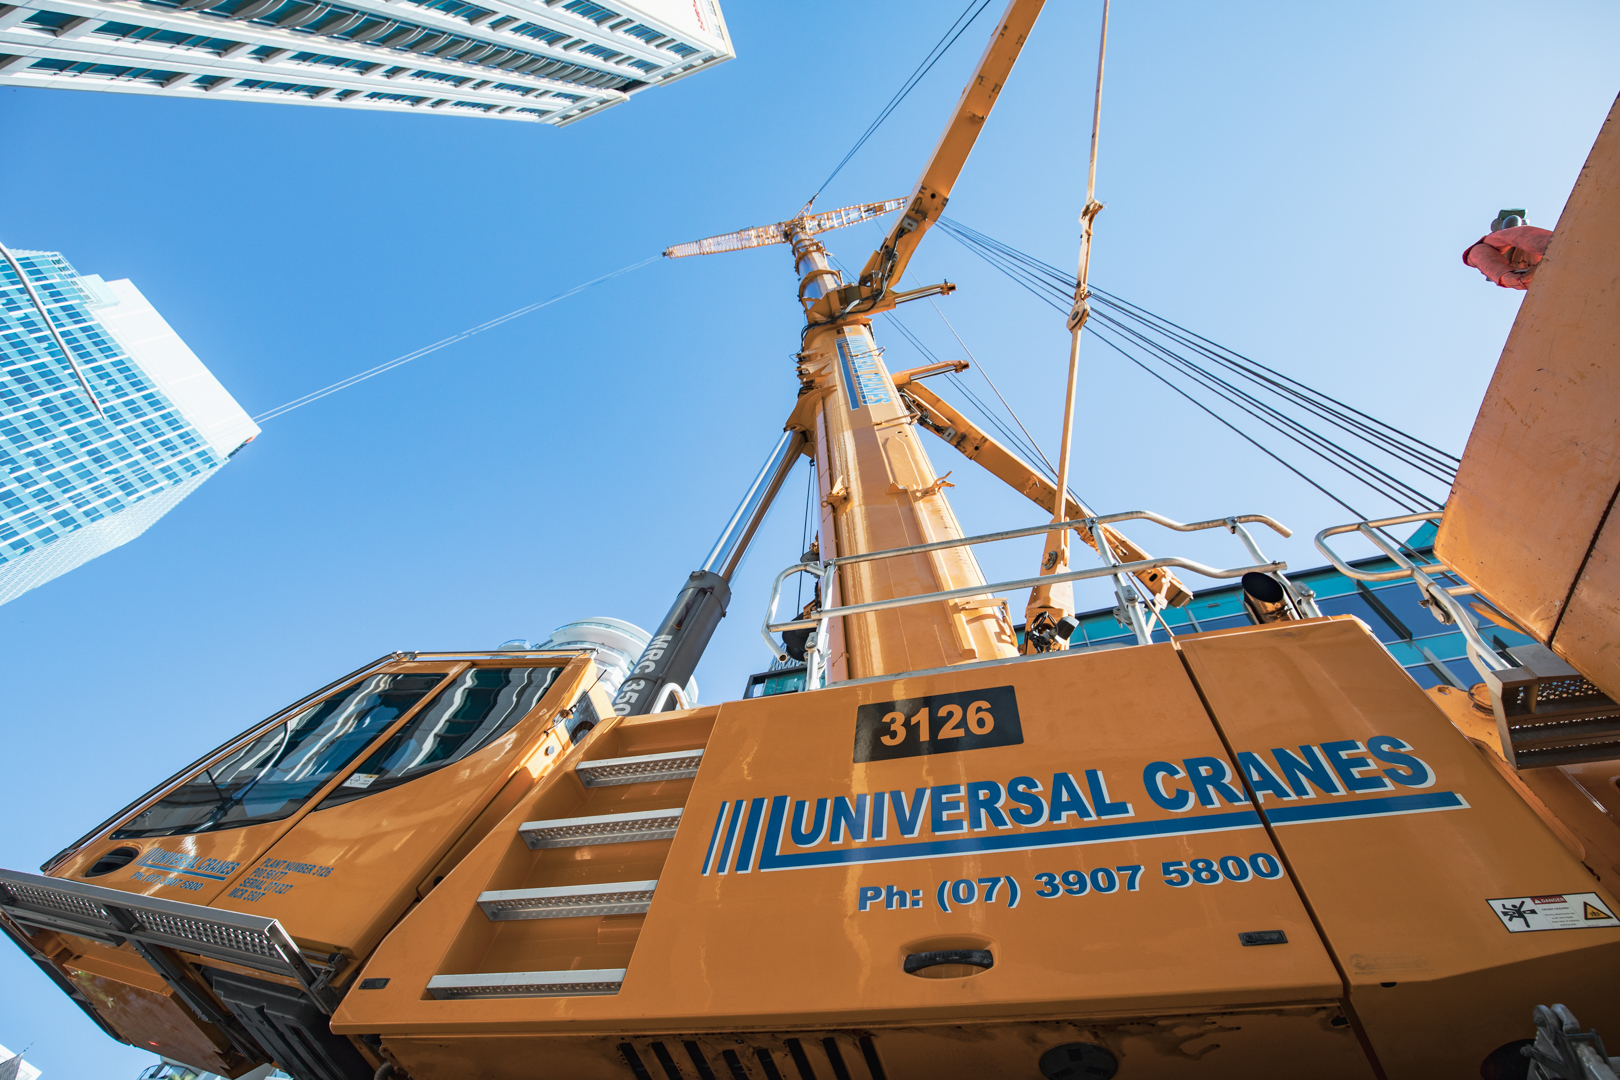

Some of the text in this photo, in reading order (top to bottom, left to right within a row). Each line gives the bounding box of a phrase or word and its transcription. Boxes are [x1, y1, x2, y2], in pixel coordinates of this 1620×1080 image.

[854, 373, 892, 405] CRANES
[613, 634, 673, 716] MRC 350
[879, 700, 995, 746] 3126
[790, 735, 1437, 848] UNIVERSAL CRANES
[150, 850, 241, 876] UNIVERSAL CRANES
[260, 857, 335, 877] PLANT NUMBER 3126
[180, 880, 205, 891] 5800
[239, 877, 268, 890] SERIAL
[857, 852, 1284, 913] Ph: (07) 3907 5800
